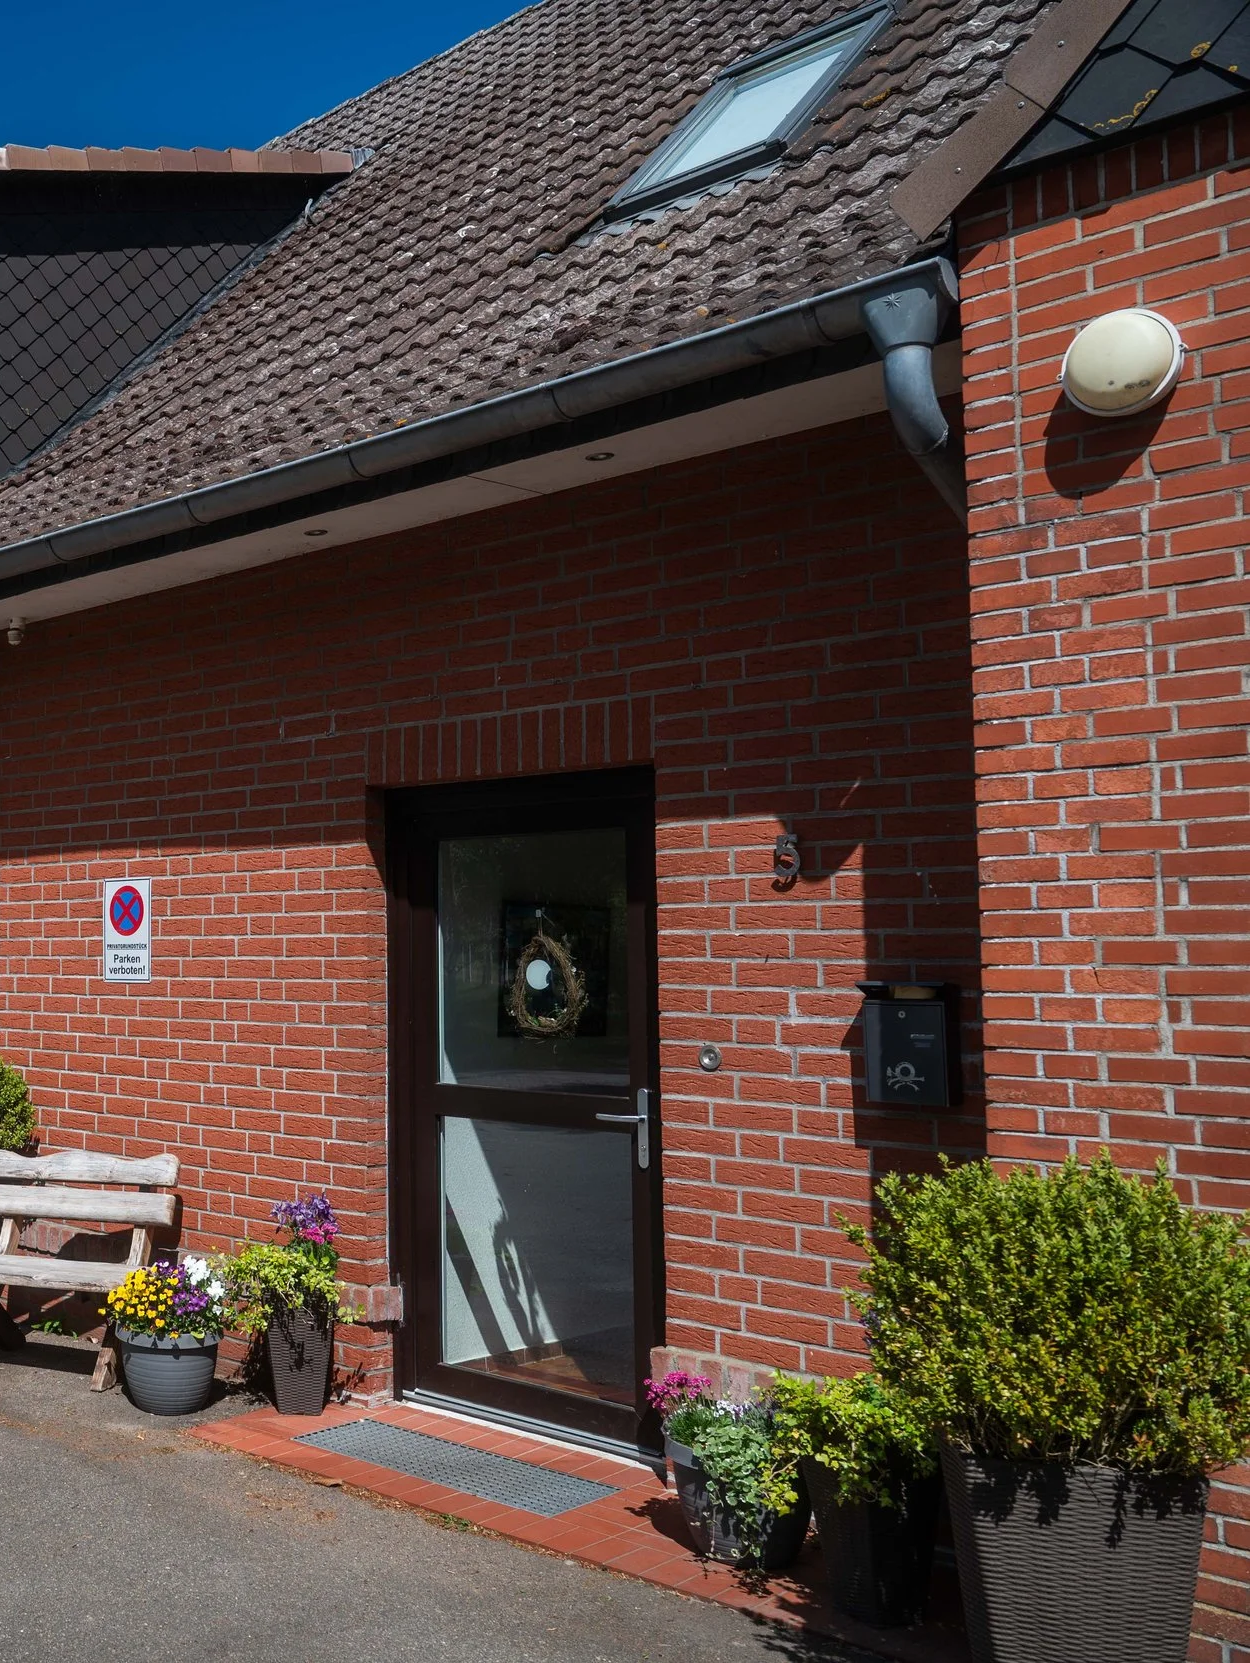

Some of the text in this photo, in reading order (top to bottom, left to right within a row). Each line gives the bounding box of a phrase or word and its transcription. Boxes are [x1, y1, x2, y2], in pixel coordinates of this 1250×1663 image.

[774, 834, 800, 877] 5
[113, 953, 141, 964] Parken
[108, 965, 146, 975] verboten!
